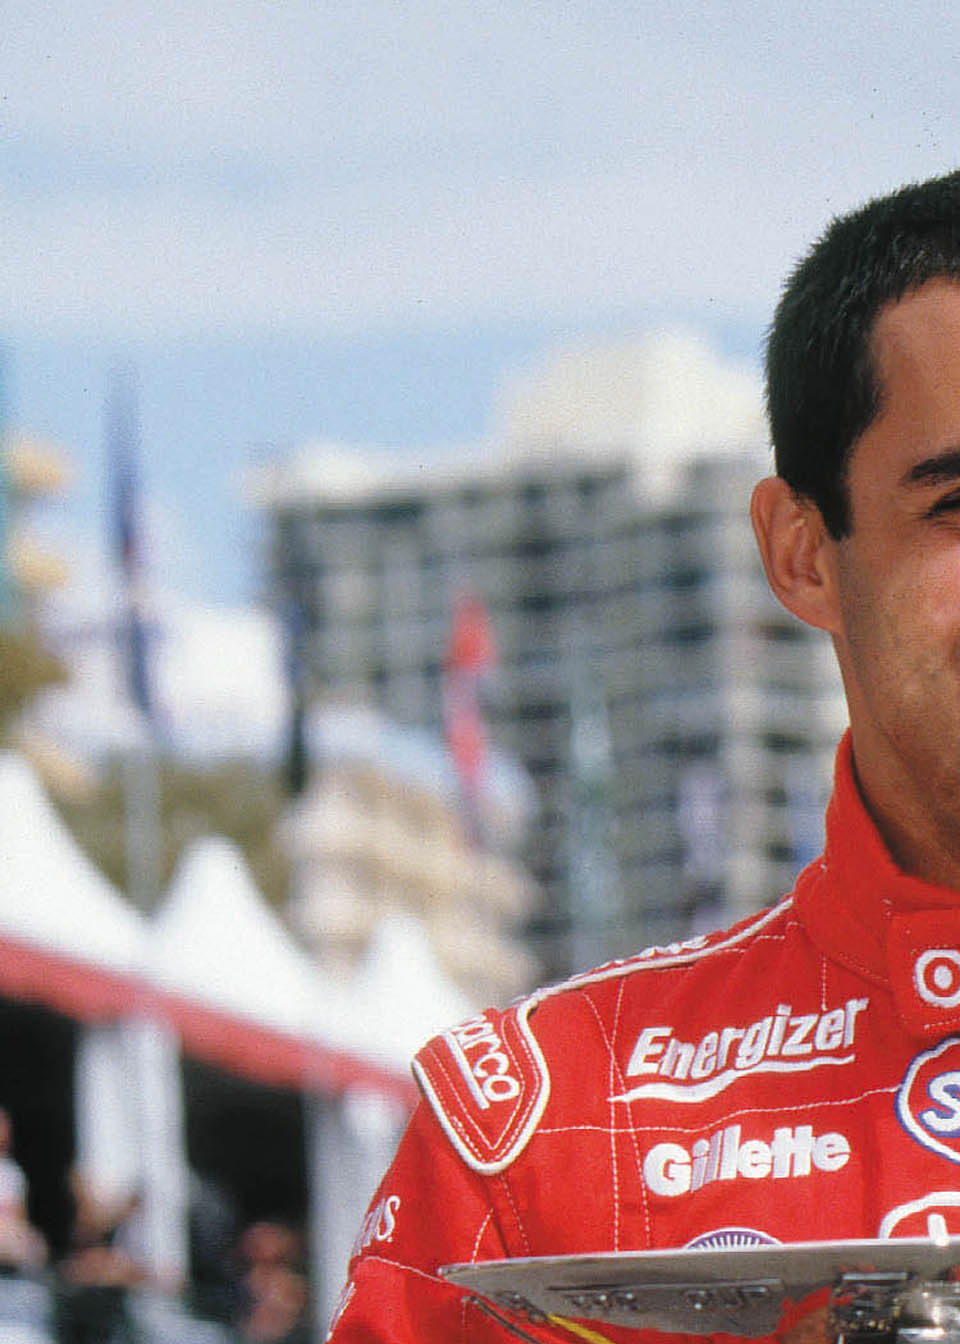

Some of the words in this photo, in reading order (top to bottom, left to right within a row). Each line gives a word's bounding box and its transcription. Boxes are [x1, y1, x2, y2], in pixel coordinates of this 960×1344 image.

[450, 1014, 521, 1102] arco
[626, 997, 869, 1081] Energizer
[643, 1124, 851, 1198] Gillette
